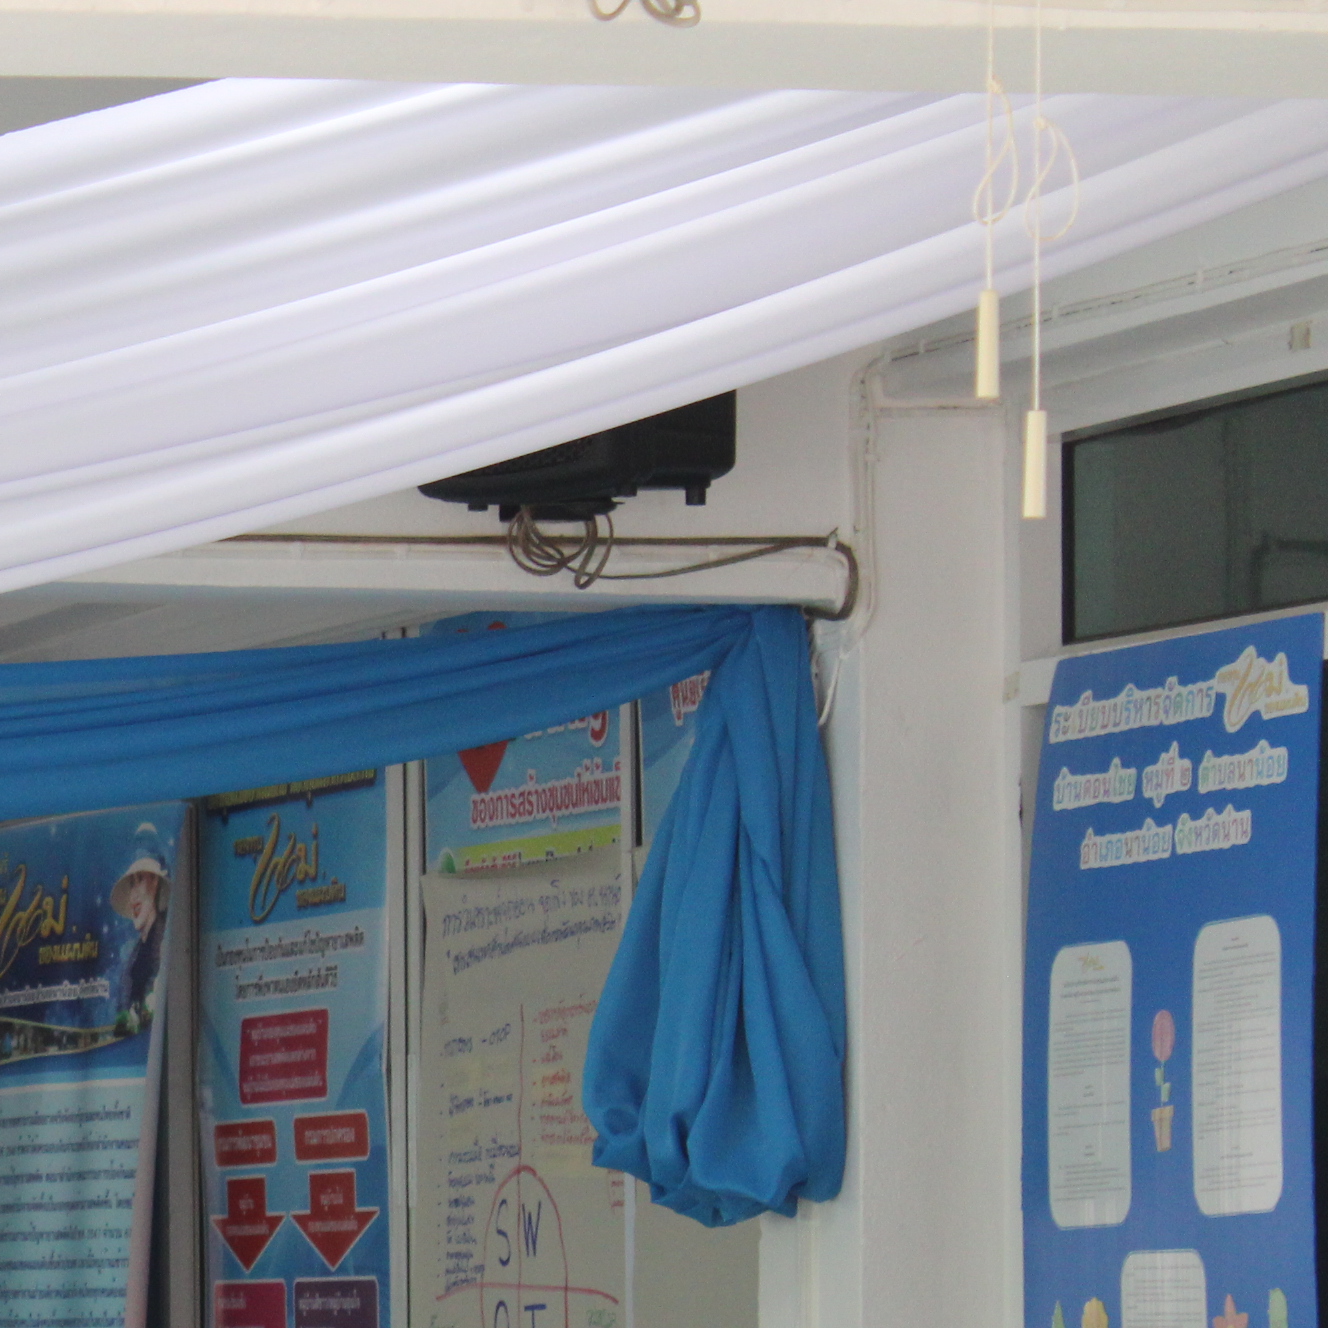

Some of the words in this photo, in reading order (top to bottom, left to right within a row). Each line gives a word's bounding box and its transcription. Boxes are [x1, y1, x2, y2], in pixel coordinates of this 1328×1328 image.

[470, 758, 621, 825] ของการสร้างชุมชนให้เข้มแข็
[495, 1199, 511, 1266] S
[522, 1201, 542, 1257] W
